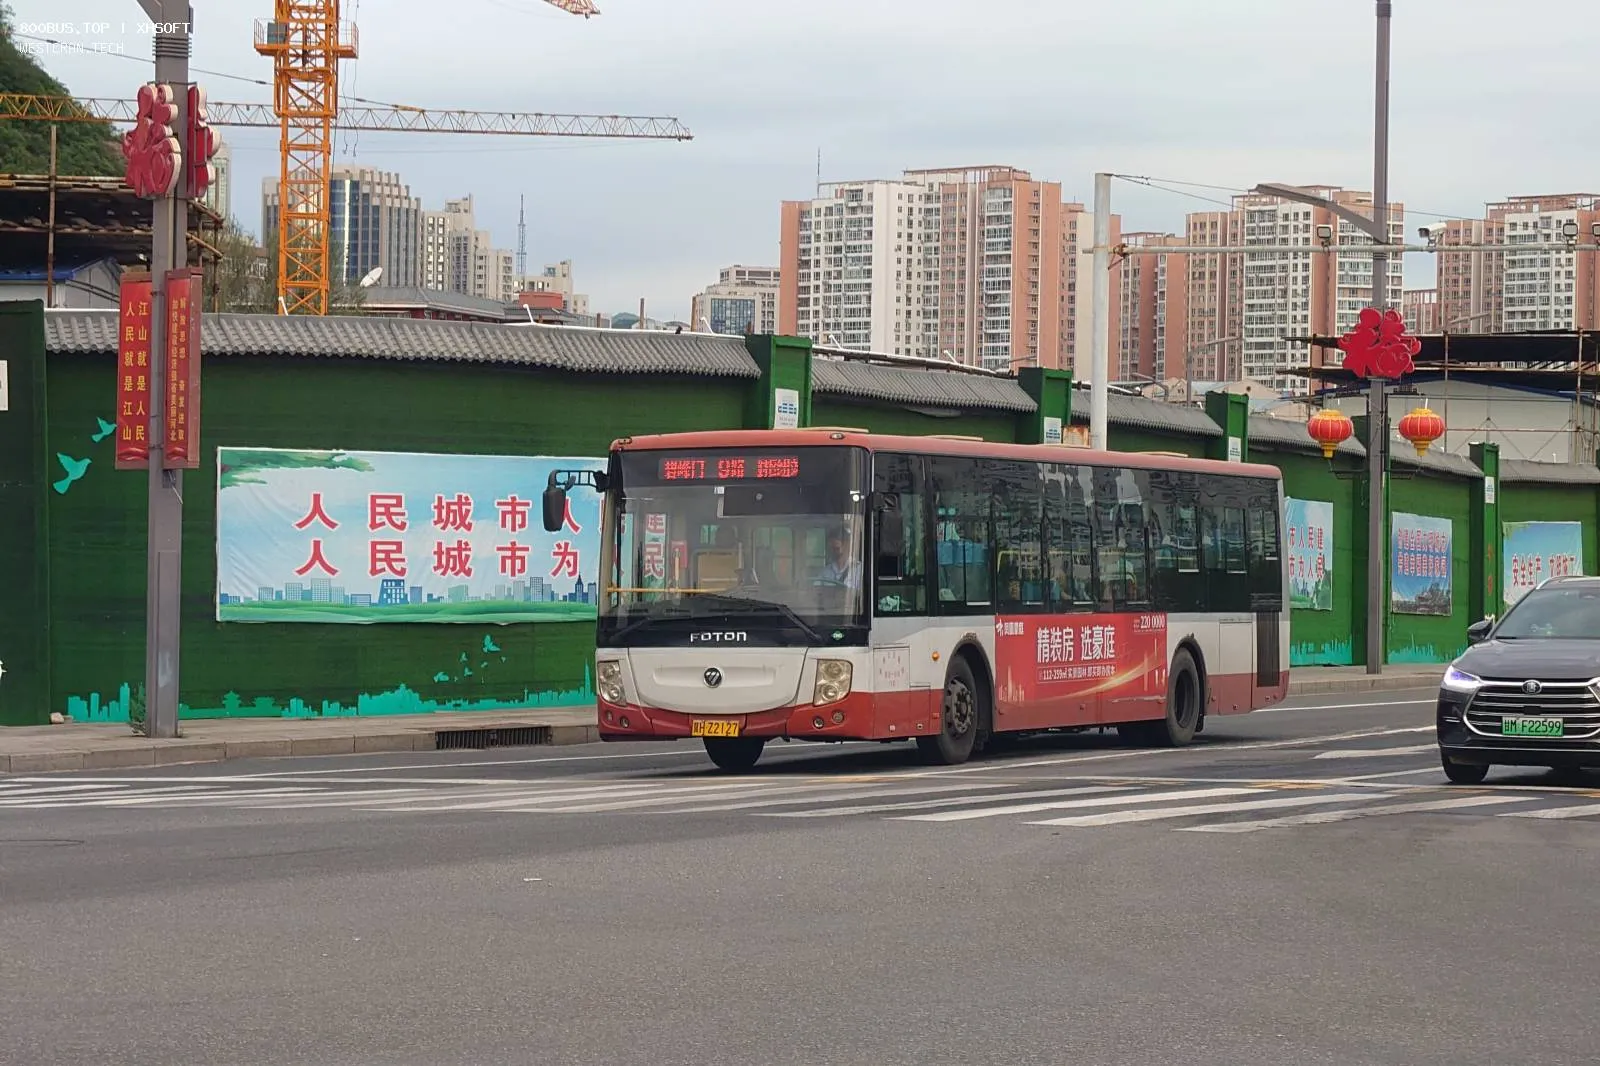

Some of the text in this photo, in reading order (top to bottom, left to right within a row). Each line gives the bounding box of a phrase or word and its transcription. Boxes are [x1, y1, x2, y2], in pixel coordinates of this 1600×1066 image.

[122, 301, 135, 442] 人民就是江山
[135, 301, 149, 442] 江山就是人民
[690, 631, 747, 643] FOTON
[1037, 626, 1074, 663] 精装房
[1080, 624, 1116, 660] 选豪庭
